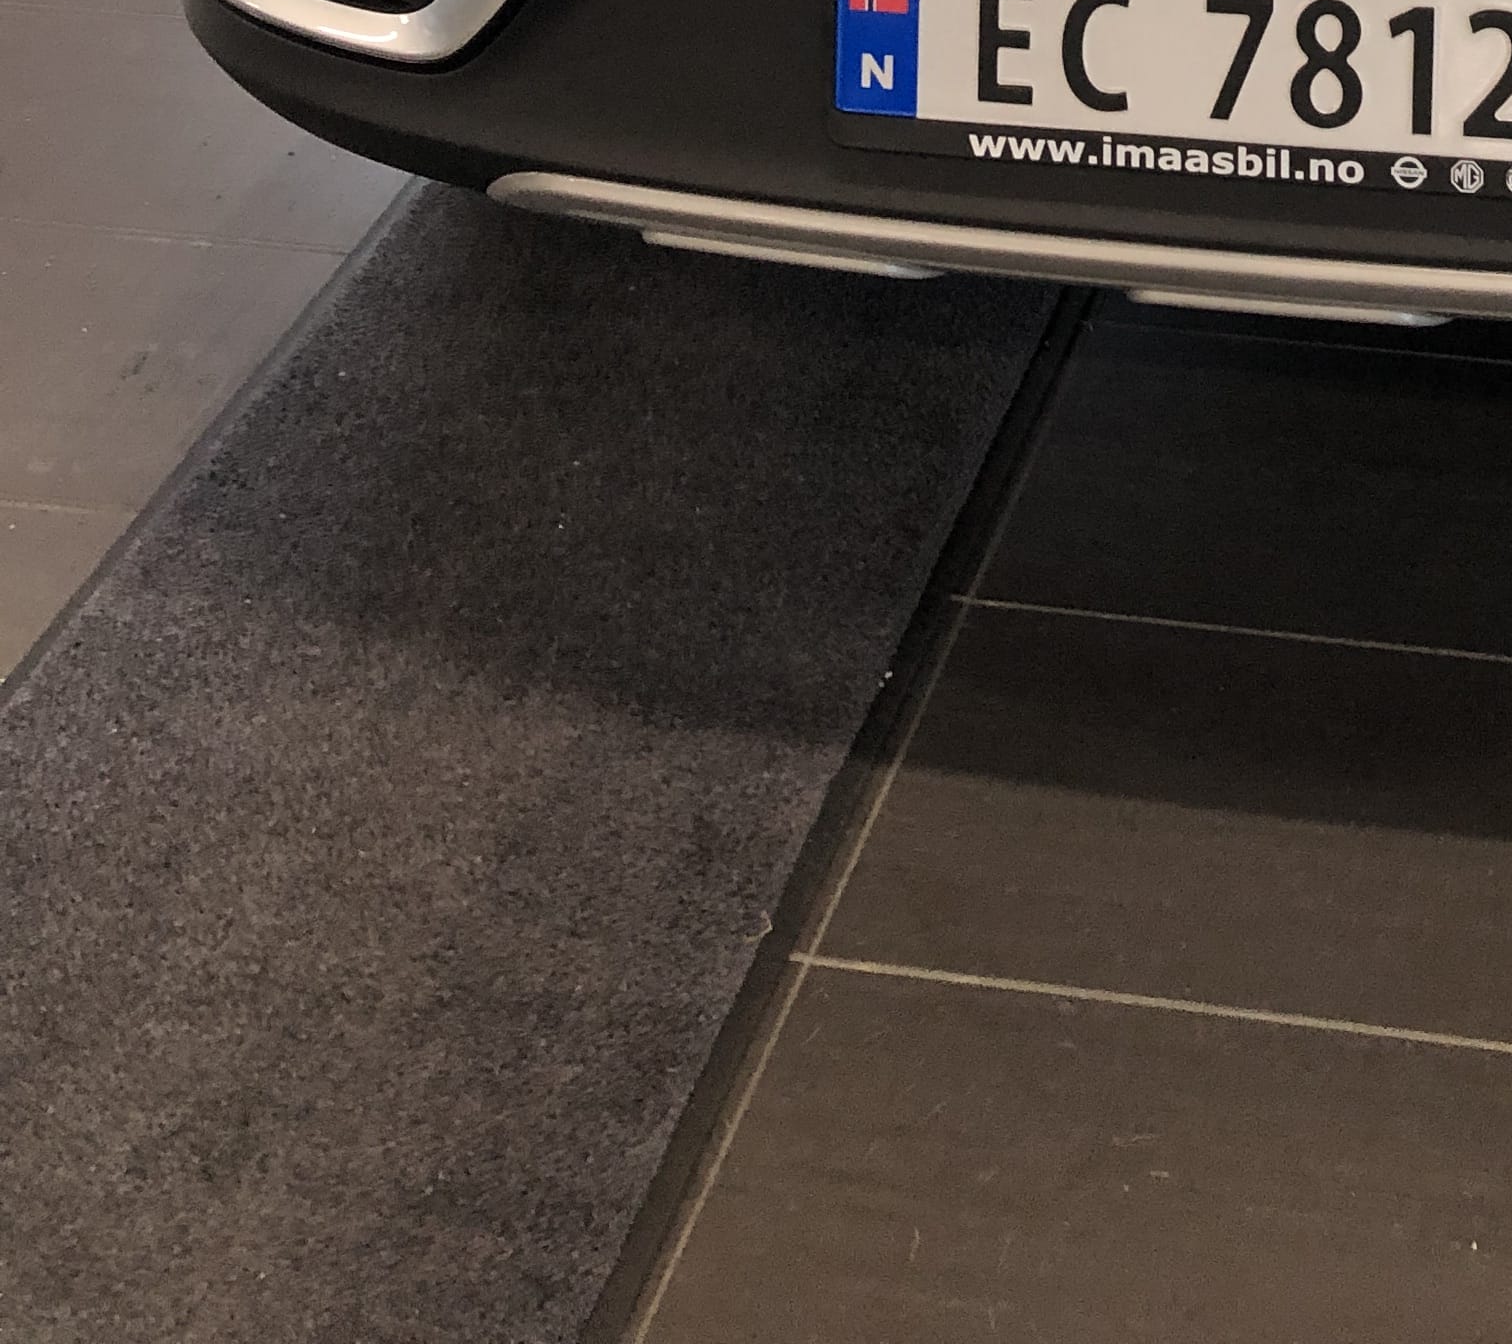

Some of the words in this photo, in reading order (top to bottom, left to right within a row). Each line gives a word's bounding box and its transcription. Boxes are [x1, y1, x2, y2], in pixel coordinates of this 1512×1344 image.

[861, 52, 894, 90] N
[968, 129, 1365, 186] www.imaasbil.no
[1453, 162, 1481, 191] MG
